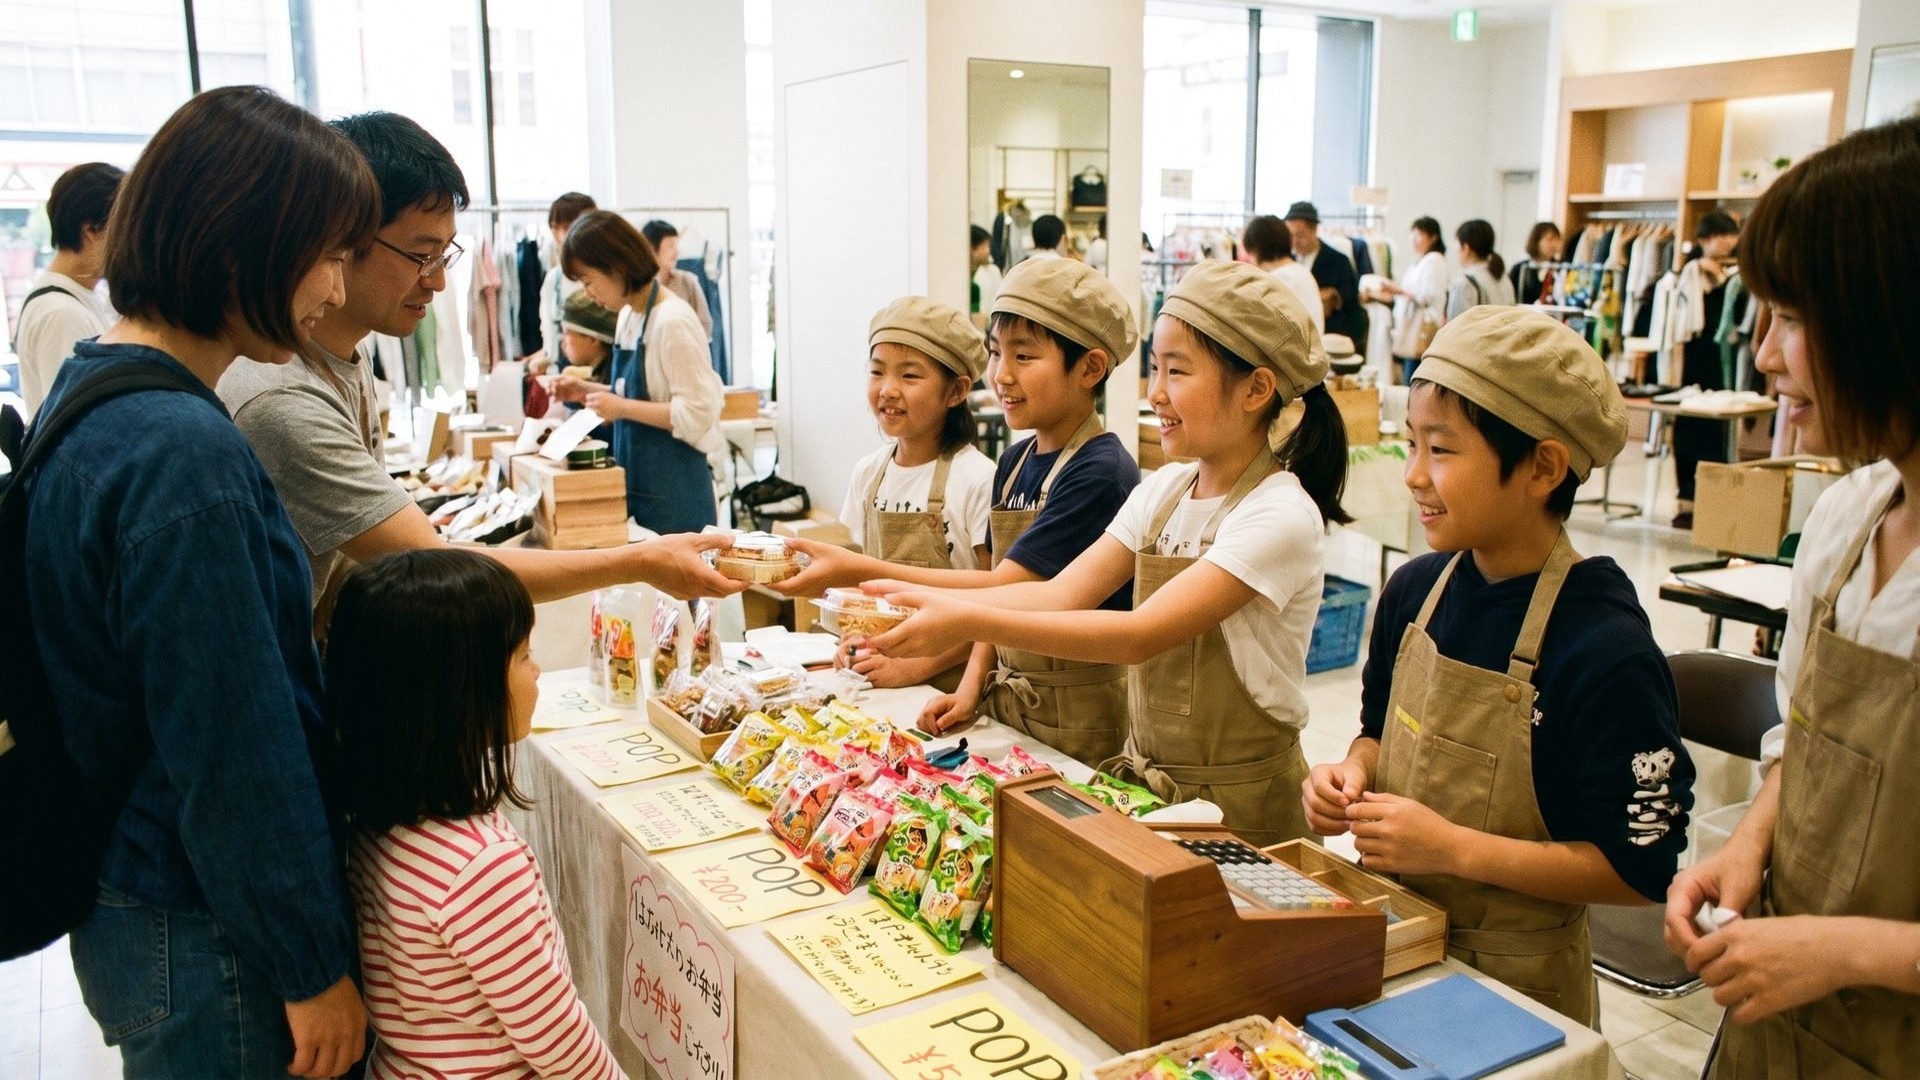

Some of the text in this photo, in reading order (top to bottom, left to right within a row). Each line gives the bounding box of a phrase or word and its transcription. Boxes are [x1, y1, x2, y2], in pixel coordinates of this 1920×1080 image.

[607, 731, 681, 765] POP
[728, 847, 826, 897] POP
[633, 957, 682, 1045] お弁当
[929, 1006, 1068, 1080] POP
